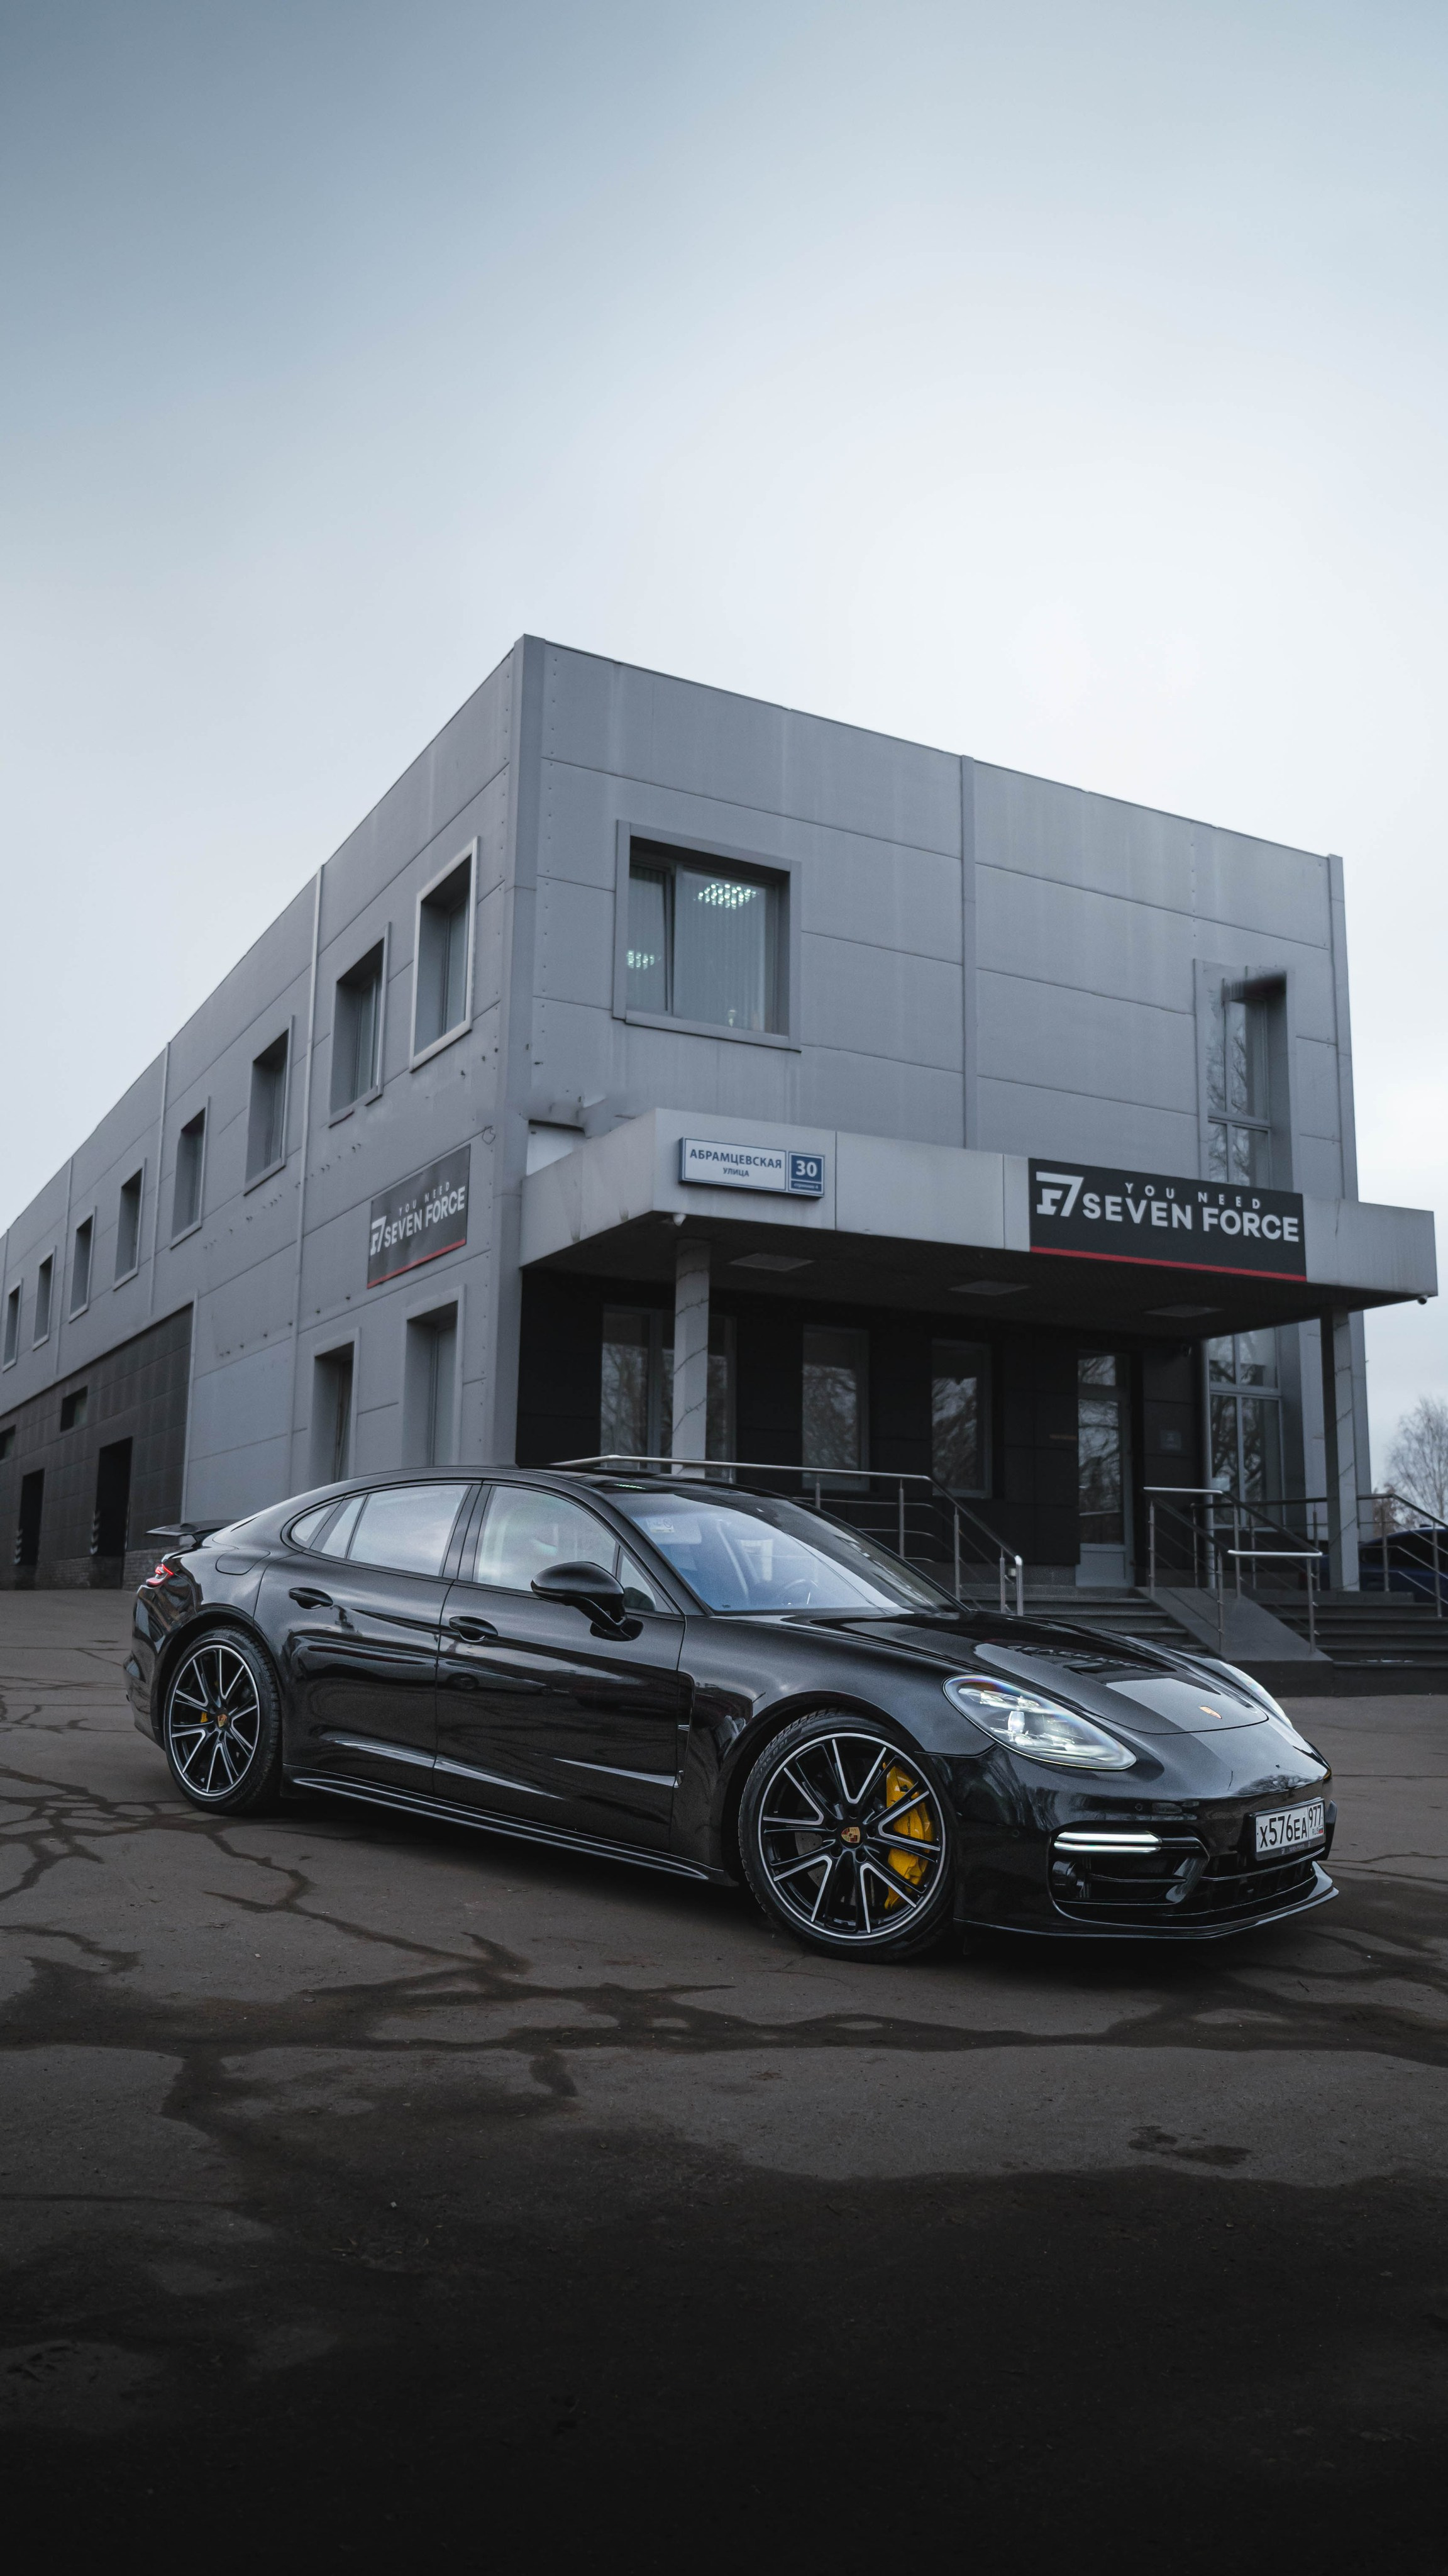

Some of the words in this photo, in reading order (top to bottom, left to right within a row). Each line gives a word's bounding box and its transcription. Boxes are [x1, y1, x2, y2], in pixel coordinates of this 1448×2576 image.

[690, 1149, 782, 1169] АБРАМЦЕВСКАЯ
[795, 1160, 817, 1177] 30
[723, 1167, 749, 1177] УЛИЦА
[399, 1199, 417, 1217] YOU
[424, 1181, 450, 1203] NEED
[1125, 1182, 1174, 1199] YOU
[1198, 1191, 1261, 1209] NEED
[384, 1209, 423, 1248] SEVEN
[425, 1185, 466, 1228] FORCE
[1082, 1192, 1192, 1230] SEVEN
[1202, 1207, 1300, 1242] FORCE
[1308, 1804, 1322, 1828] 977
